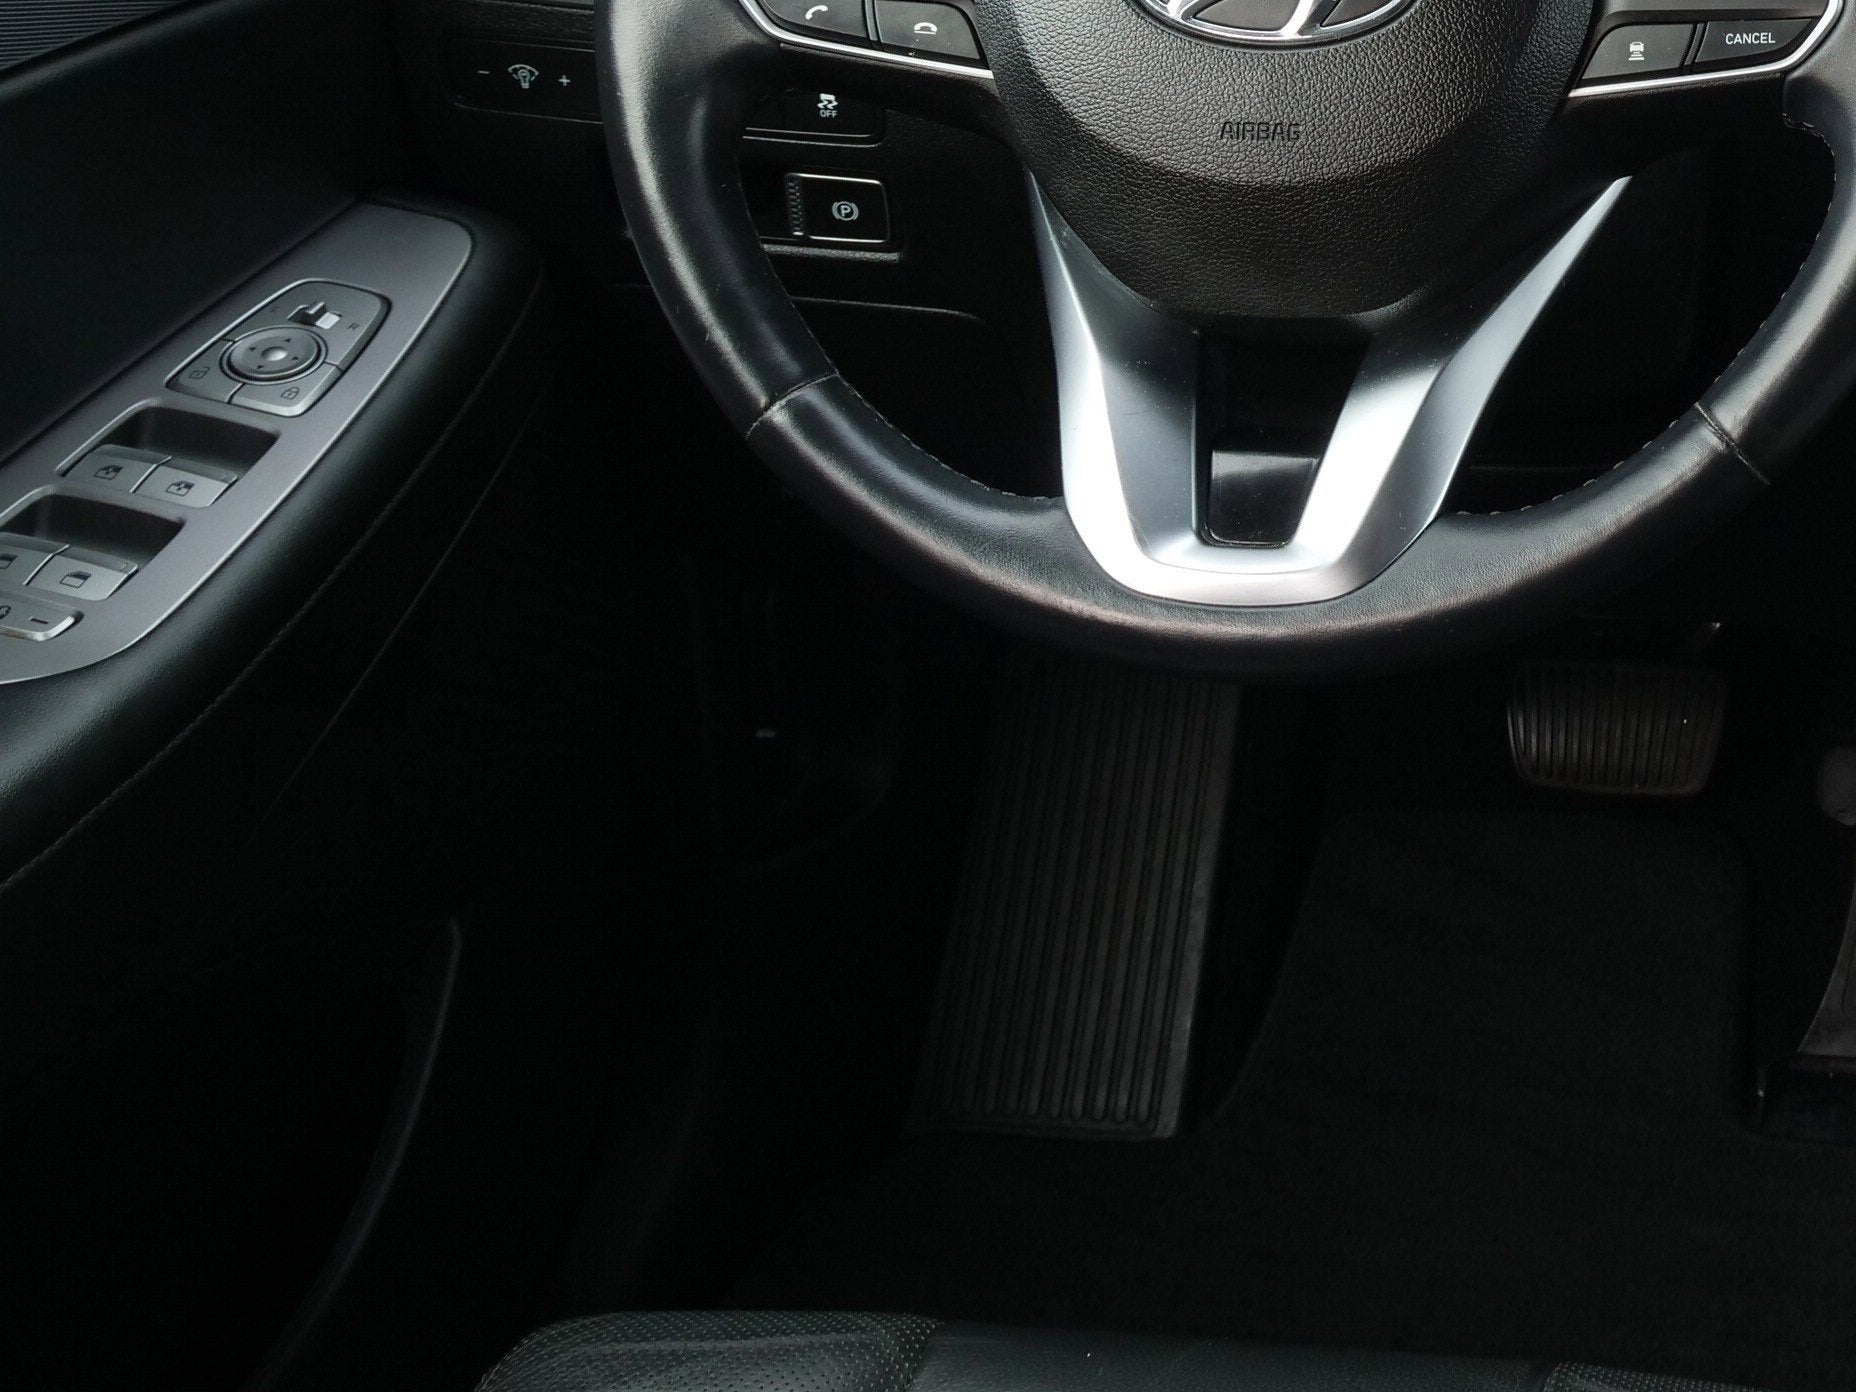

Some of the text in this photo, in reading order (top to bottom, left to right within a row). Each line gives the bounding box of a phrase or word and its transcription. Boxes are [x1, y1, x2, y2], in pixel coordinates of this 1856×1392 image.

[1725, 32, 1776, 45] CANCEL
[819, 109, 838, 118] OFF
[1220, 122, 1300, 142] AIRBAG
